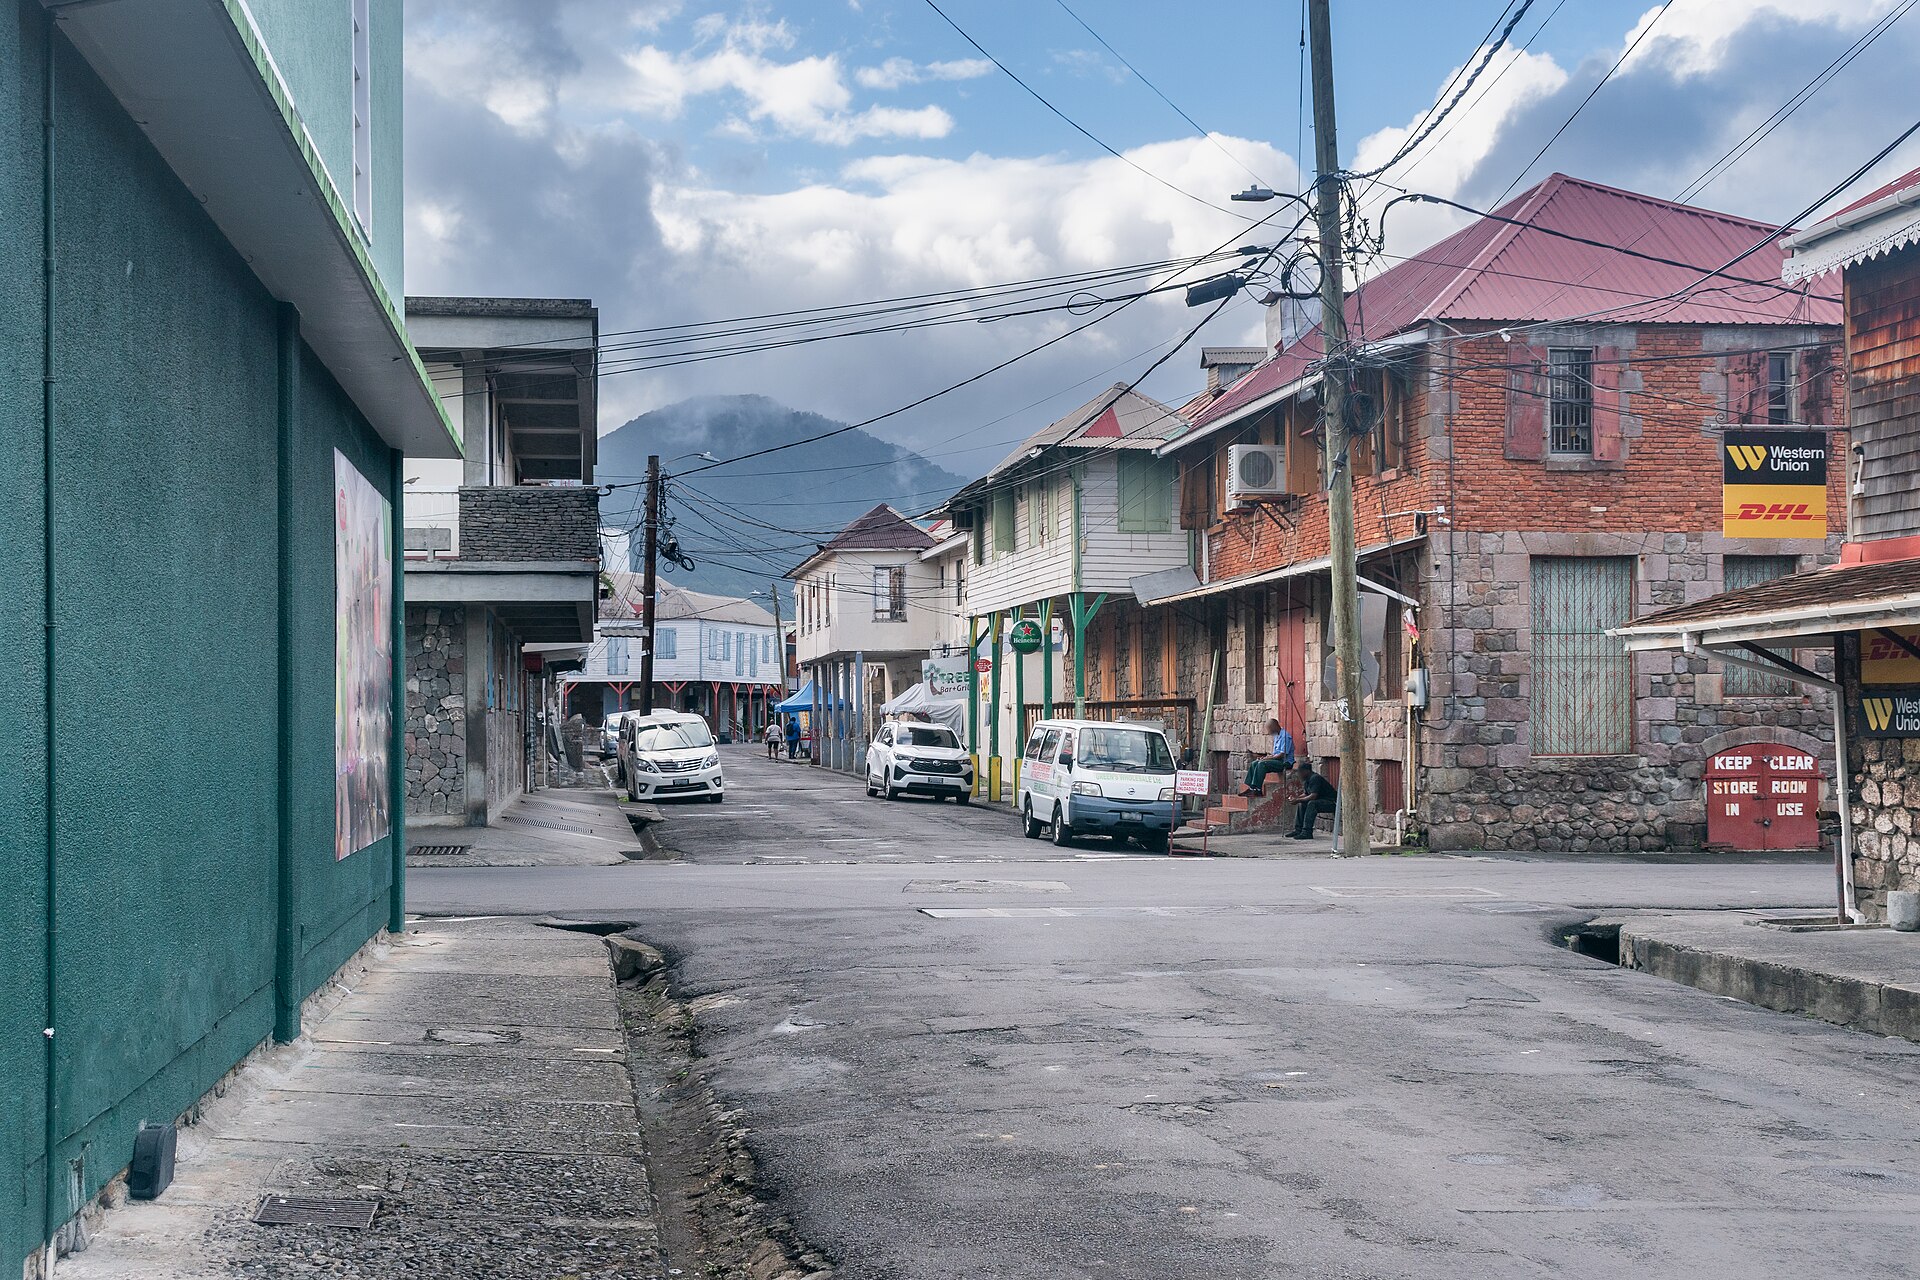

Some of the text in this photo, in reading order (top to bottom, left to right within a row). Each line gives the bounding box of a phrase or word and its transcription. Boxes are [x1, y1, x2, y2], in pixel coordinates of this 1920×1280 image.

[1770, 445, 1825, 459] Western
[1770, 458, 1810, 471] Union
[1737, 503, 1814, 520] DHL
[1714, 755, 1814, 770] KEEP CLEAR
[1713, 780, 1807, 794] STORE ROOM
[1725, 802, 1804, 816] IN USE
